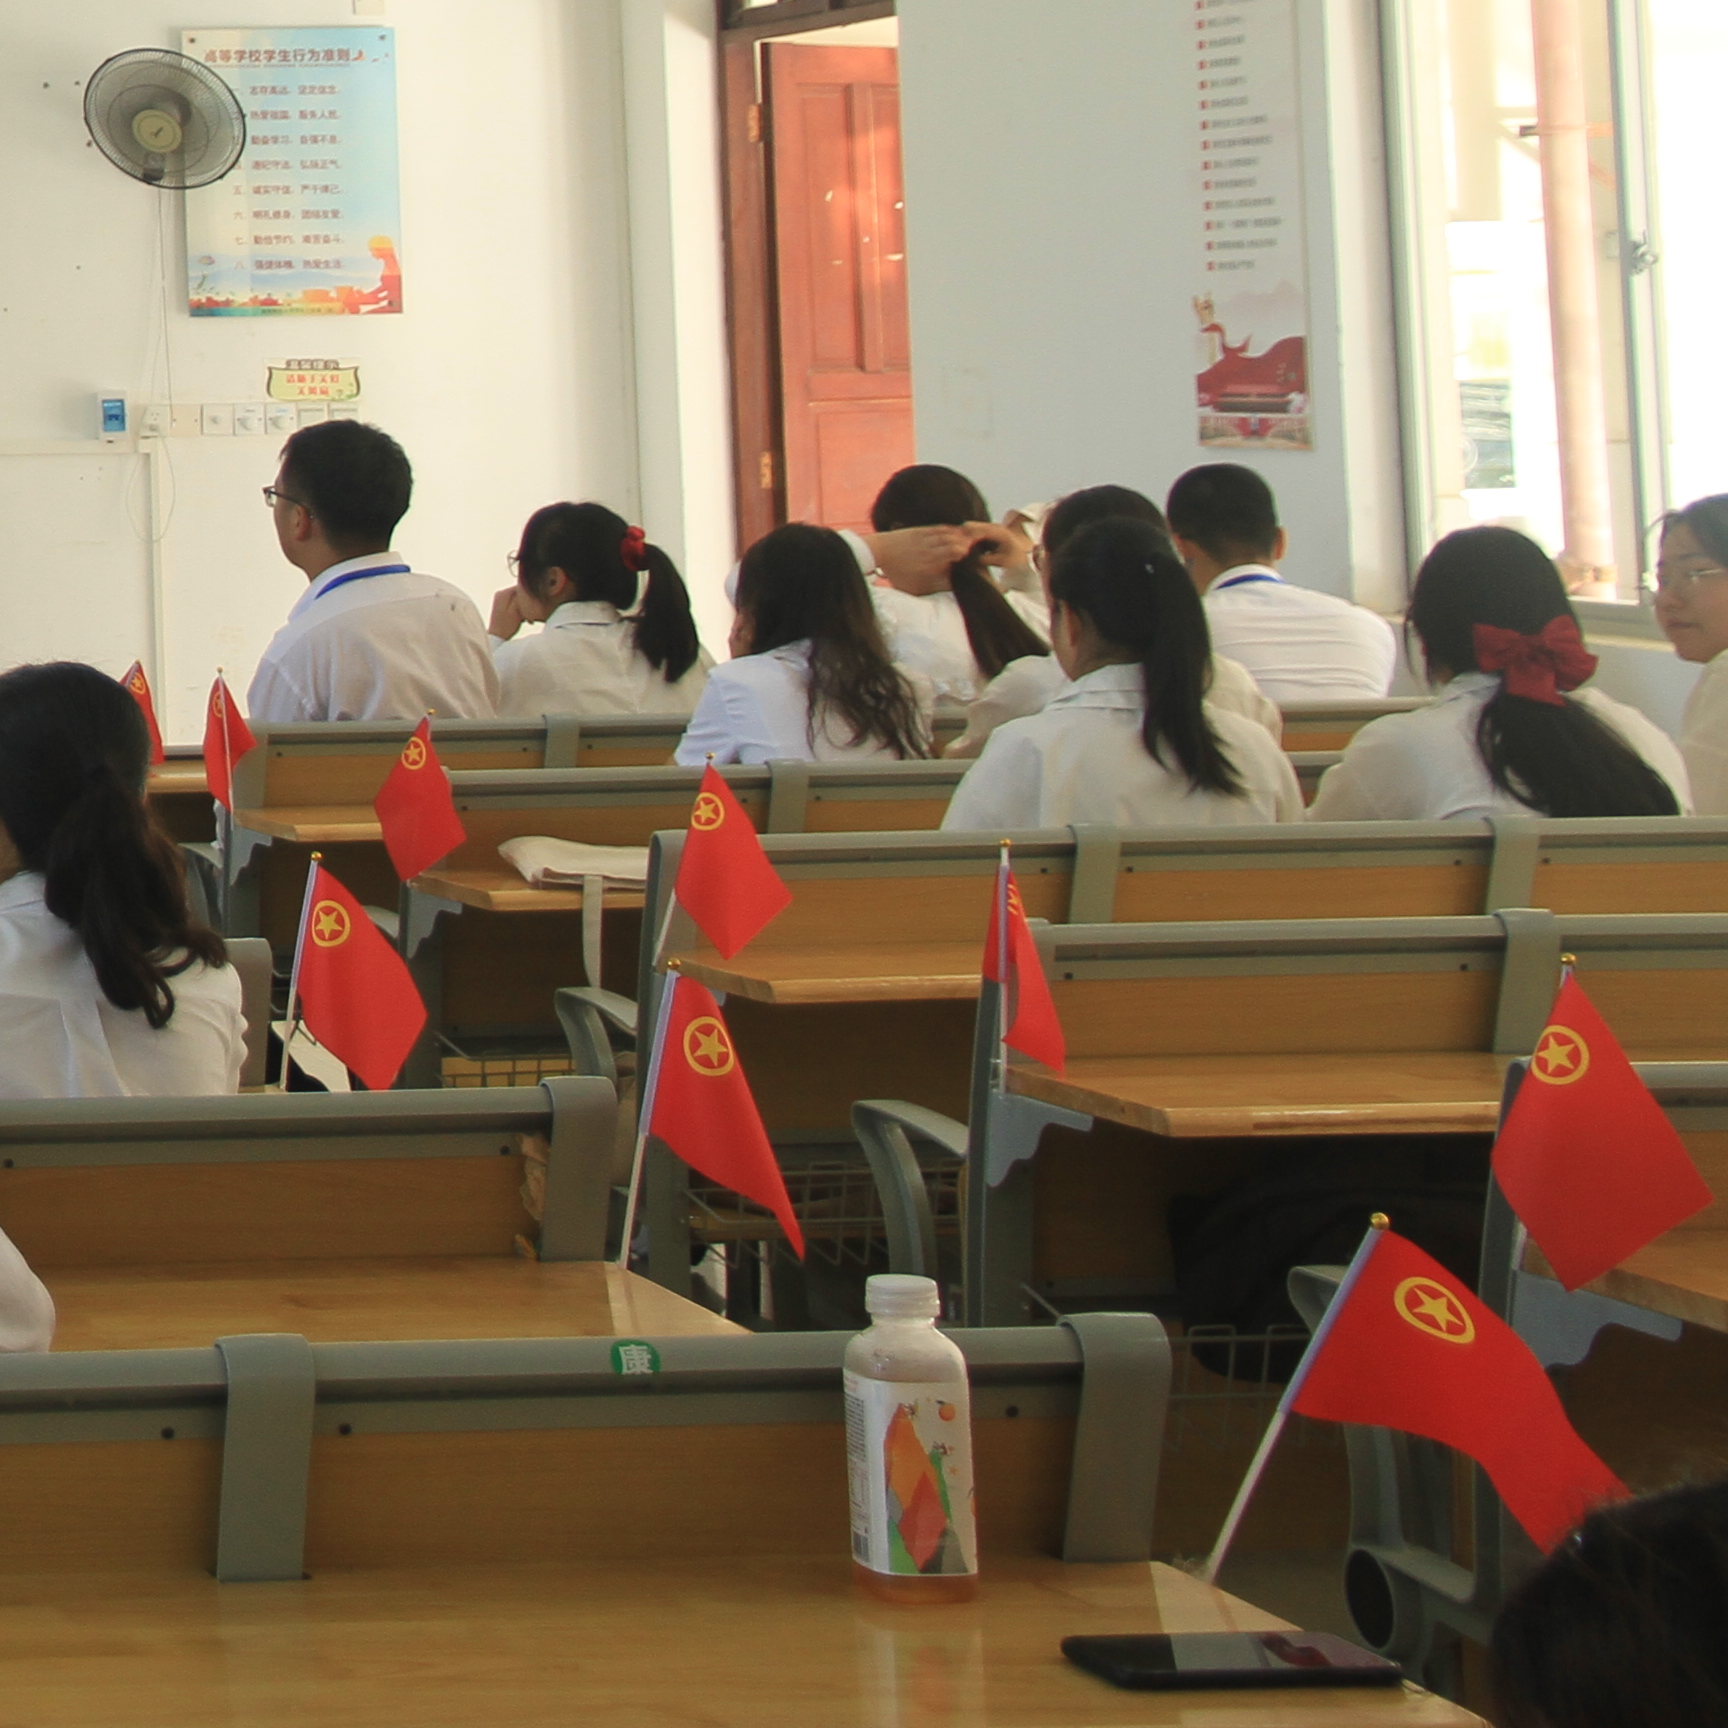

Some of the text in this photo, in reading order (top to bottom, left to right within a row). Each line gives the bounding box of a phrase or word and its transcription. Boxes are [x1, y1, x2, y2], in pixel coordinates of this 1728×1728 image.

[204, 48, 351, 63] 高等学校学生行为准则
[618, 1344, 653, 1375] 康
